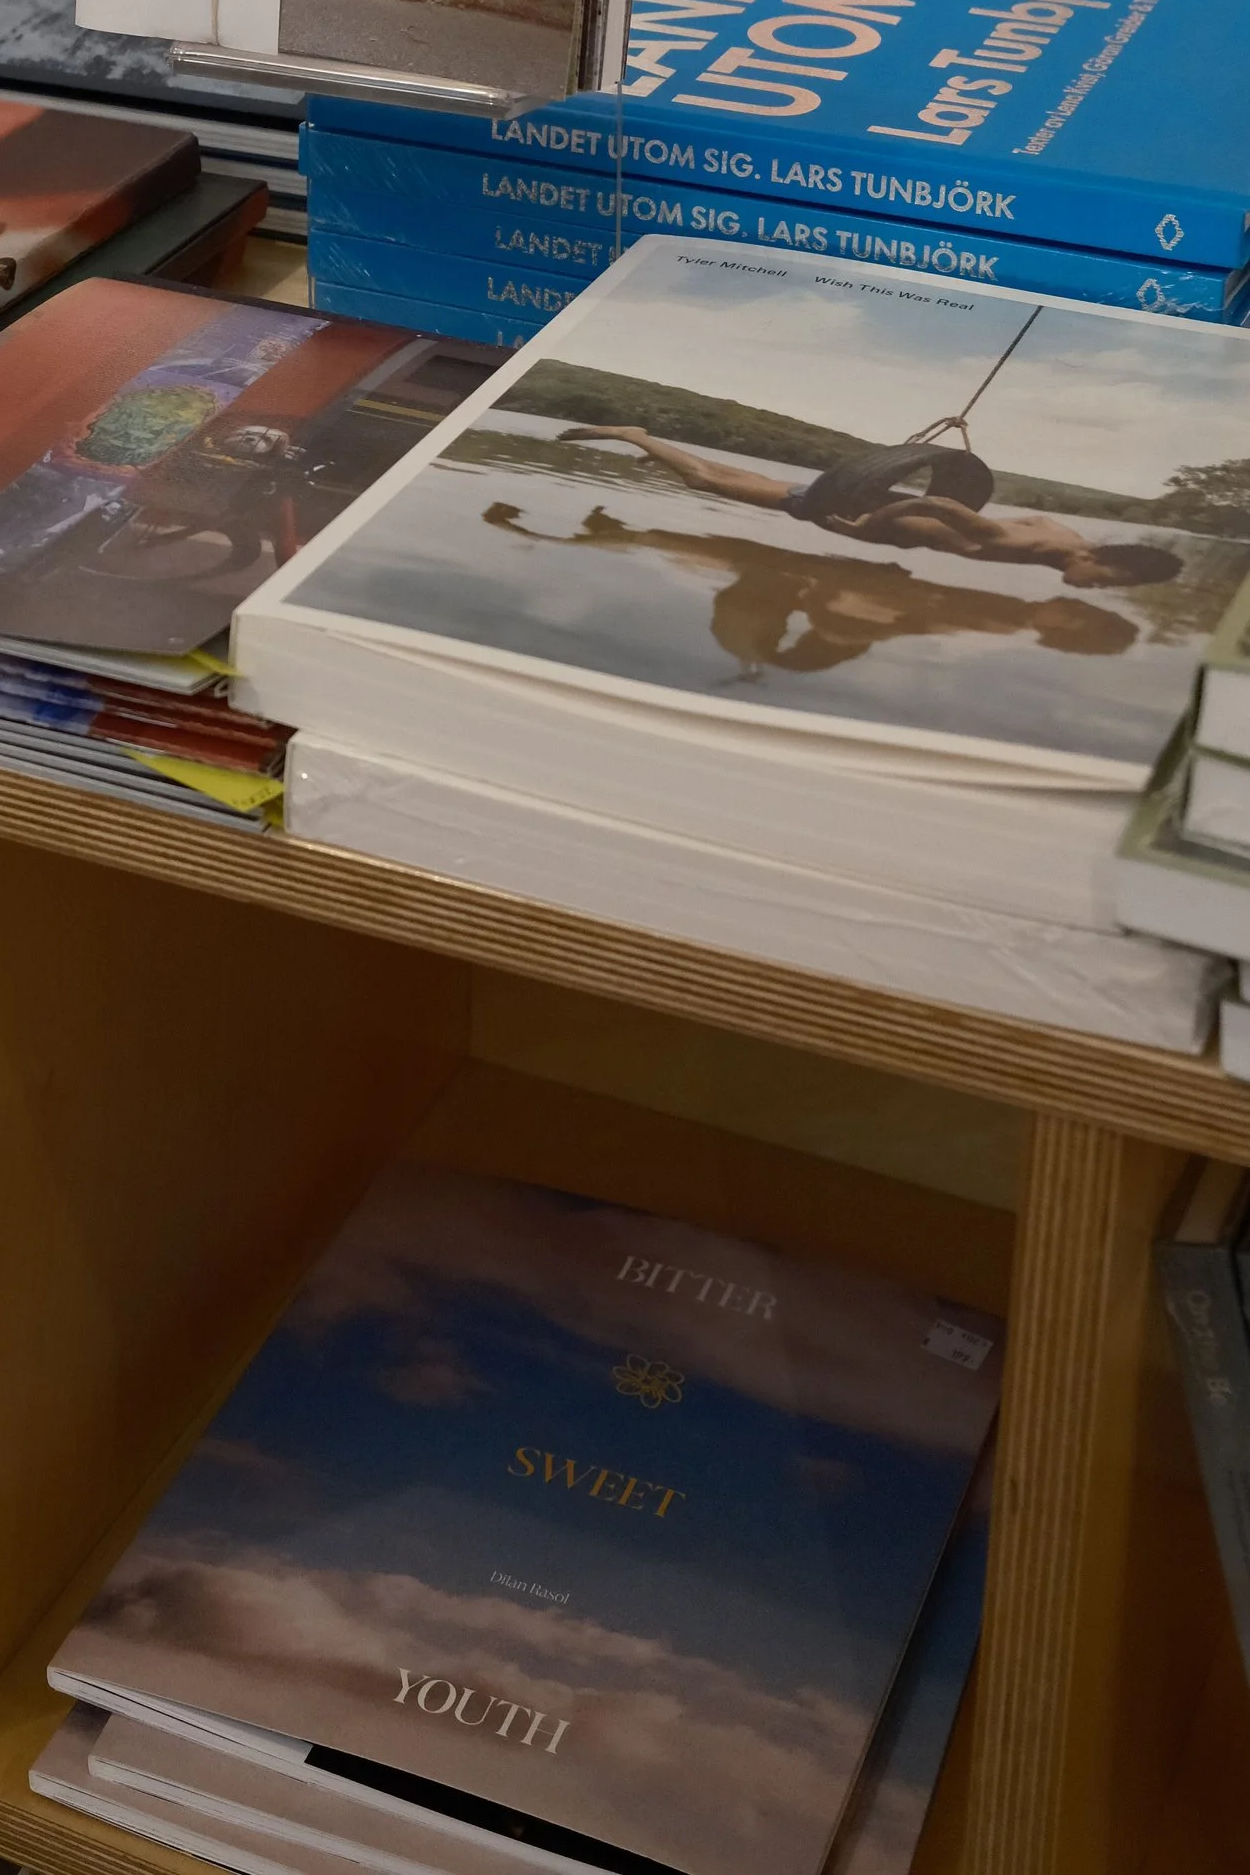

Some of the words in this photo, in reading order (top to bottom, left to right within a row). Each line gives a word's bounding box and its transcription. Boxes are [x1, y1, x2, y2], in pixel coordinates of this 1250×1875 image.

[866, 75, 1014, 146] Lars
[490, 117, 602, 156] LANDET
[607, 134, 696, 170] UTOM
[702, 147, 762, 180] SIG.
[770, 158, 843, 193] LARS
[850, 169, 1017, 221] TUNBJÖRK
[481, 172, 591, 213] LANDET
[596, 191, 684, 227] UTOM
[757, 216, 829, 252] LARS
[835, 229, 999, 282] TUNBJÖRK
[495, 225, 603, 267] LANDET
[676, 254, 717, 266] Tyler
[719, 261, 788, 277] Mitchell
[814, 275, 854, 289] Wish
[859, 283, 894, 297] This
[898, 290, 933, 304] Was
[935, 297, 975, 312] Real
[614, 1254, 779, 1321] BITTER
[506, 1446, 688, 1519] SWEET
[489, 1570, 527, 1592] Dilan
[529, 1581, 570, 1605] Rasol
[392, 1666, 571, 1755] YOUTH
